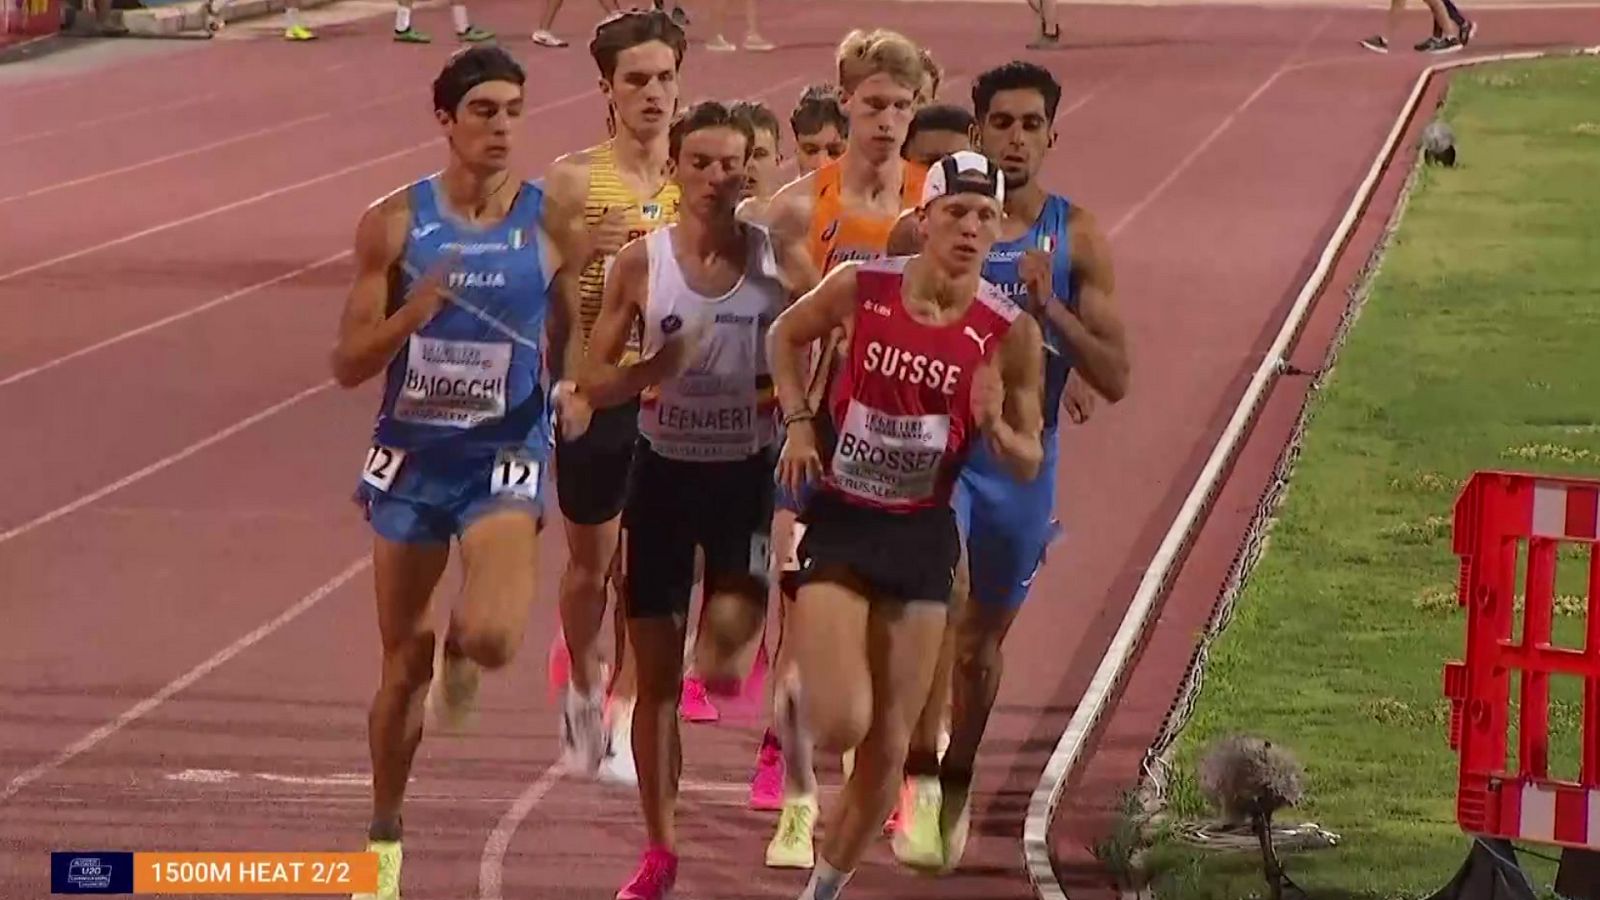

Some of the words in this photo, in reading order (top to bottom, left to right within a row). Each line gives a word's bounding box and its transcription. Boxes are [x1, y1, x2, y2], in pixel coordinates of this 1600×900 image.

[406, 369, 503, 400] BAIOCCHI
[863, 341, 962, 396] SUISSE
[366, 447, 392, 479] 12
[840, 432, 944, 474] BROSSET
[502, 460, 531, 486] 12
